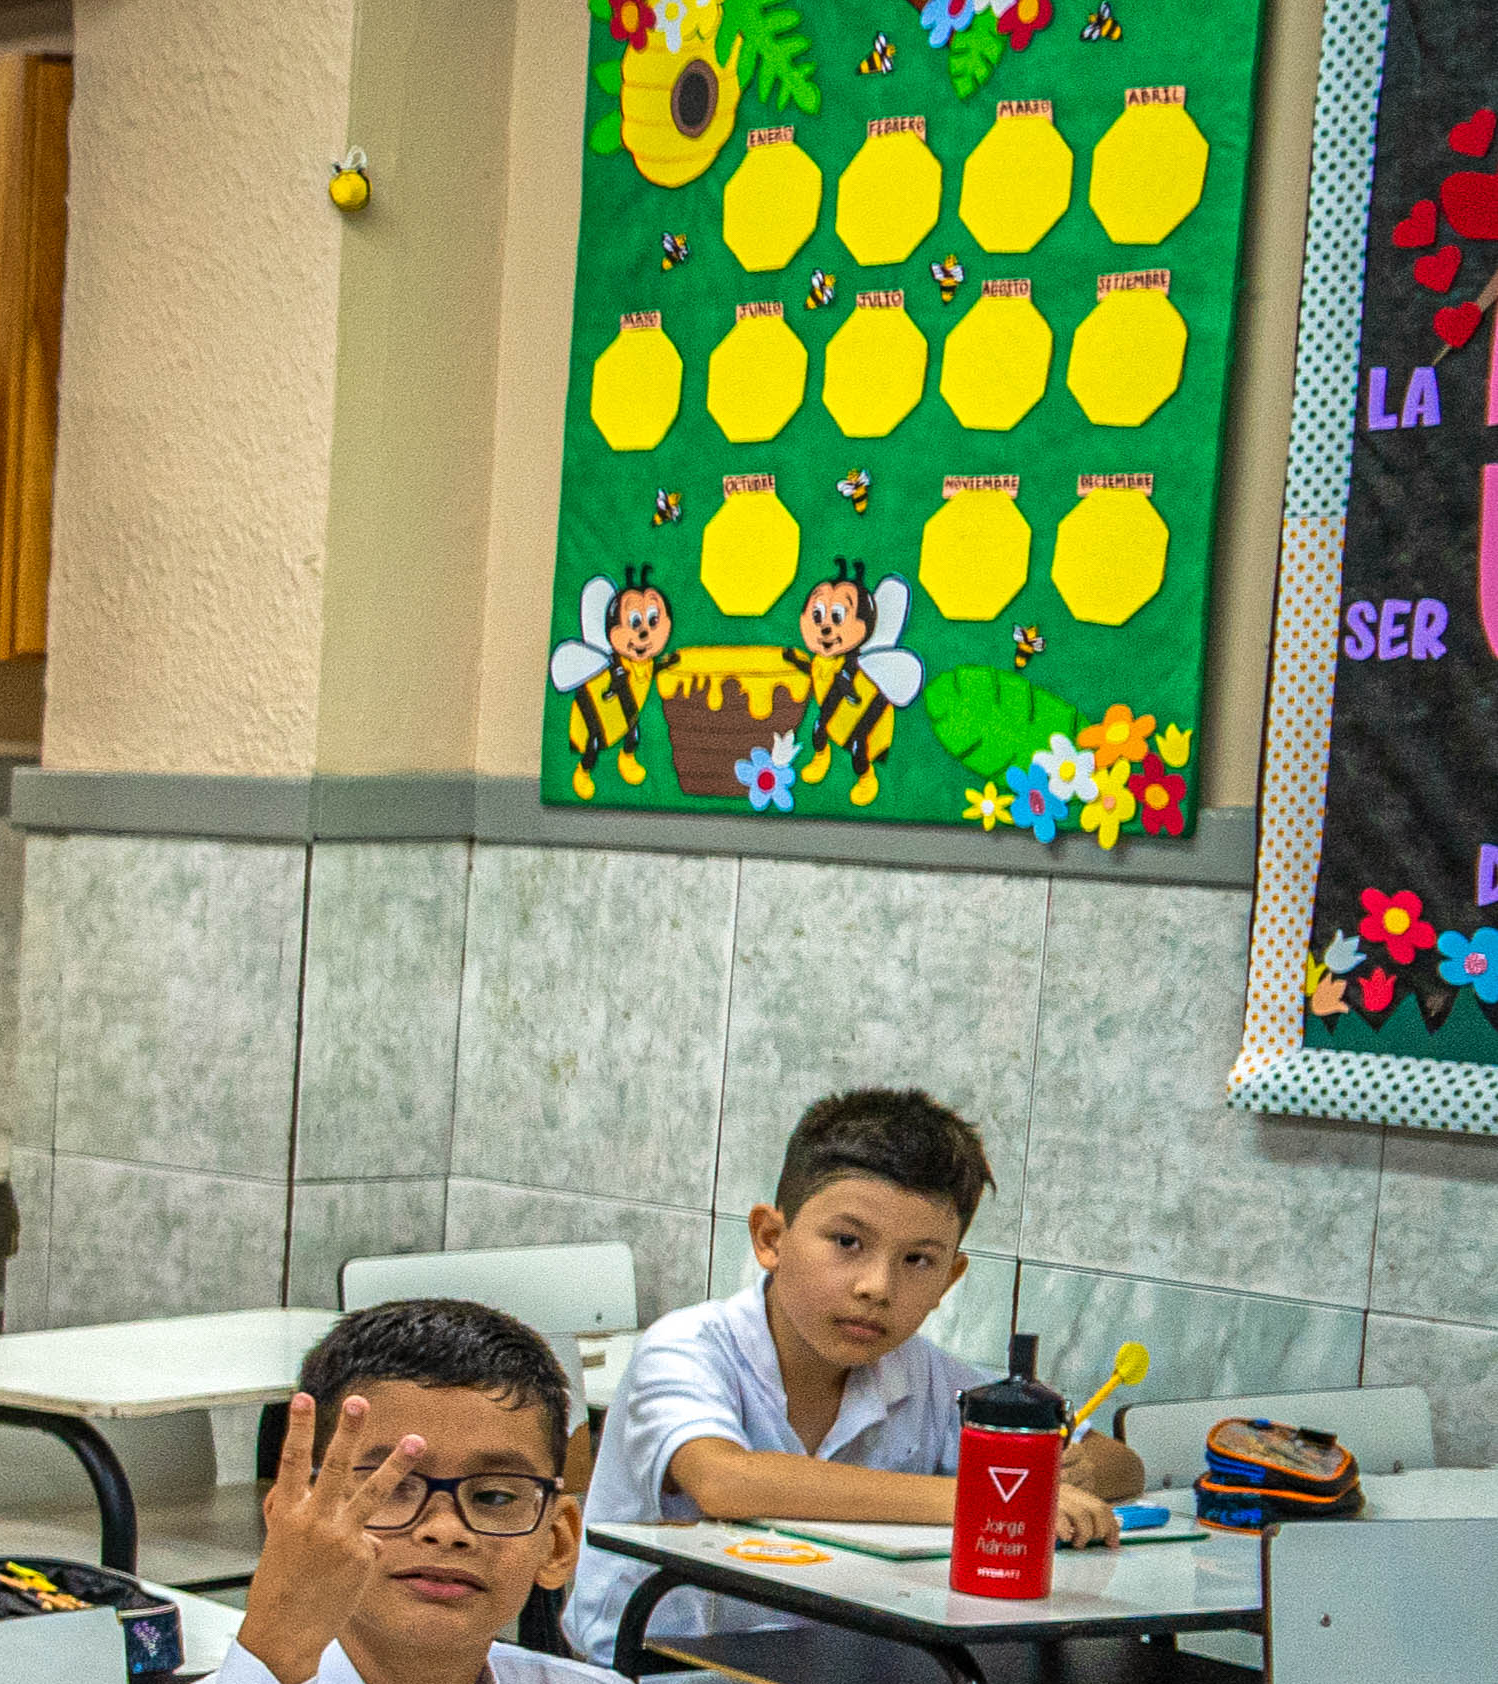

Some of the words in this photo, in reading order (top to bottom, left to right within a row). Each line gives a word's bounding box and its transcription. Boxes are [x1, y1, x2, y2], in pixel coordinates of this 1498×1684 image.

[1127, 89, 1184, 105] ABRIL
[749, 128, 793, 145] ENERO
[859, 292, 902, 308] JULIO
[1367, 366, 1441, 431] LA
[1344, 598, 1448, 661] SER
